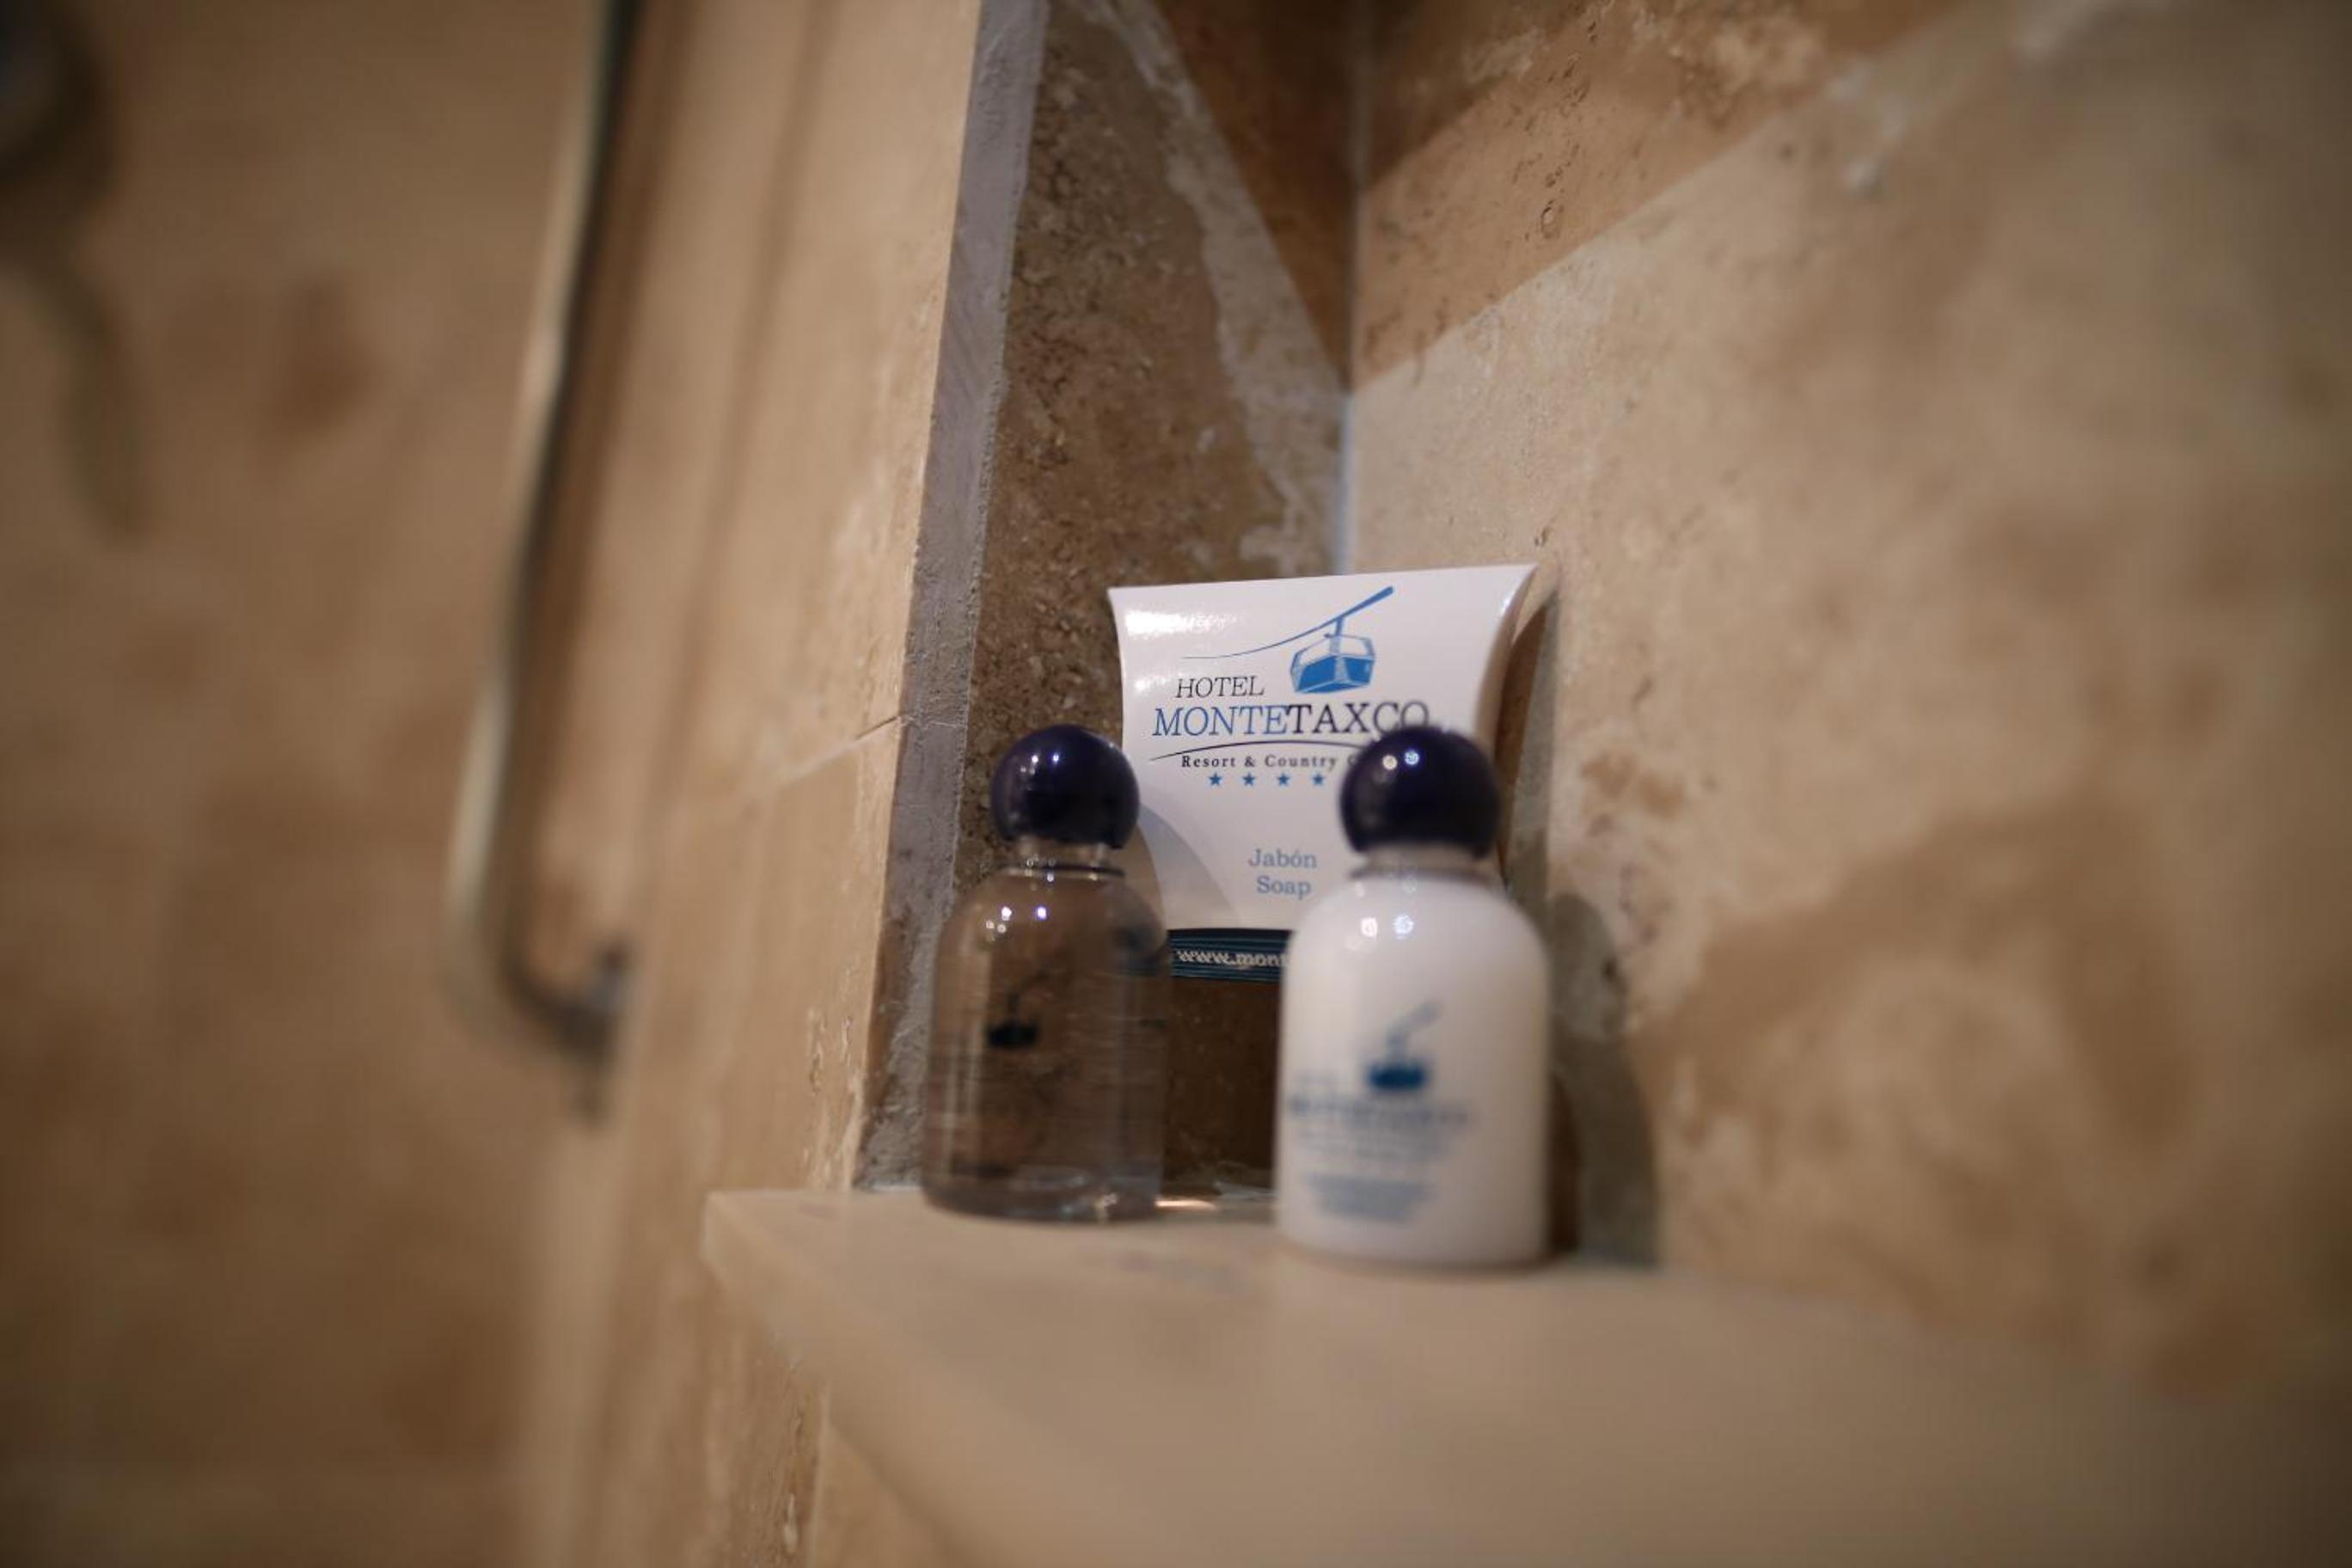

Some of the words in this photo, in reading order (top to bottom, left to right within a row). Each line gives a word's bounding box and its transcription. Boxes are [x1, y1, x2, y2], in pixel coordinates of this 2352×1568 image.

[1176, 676, 1265, 698] HOTEL
[1152, 701, 1429, 736] MONTETAXCO
[1181, 755, 1236, 769] Resort
[1244, 755, 1256, 769] &
[1265, 755, 1338, 772] Country
[1247, 848, 1317, 868] Jabón
[1257, 875, 1312, 899] Soap
